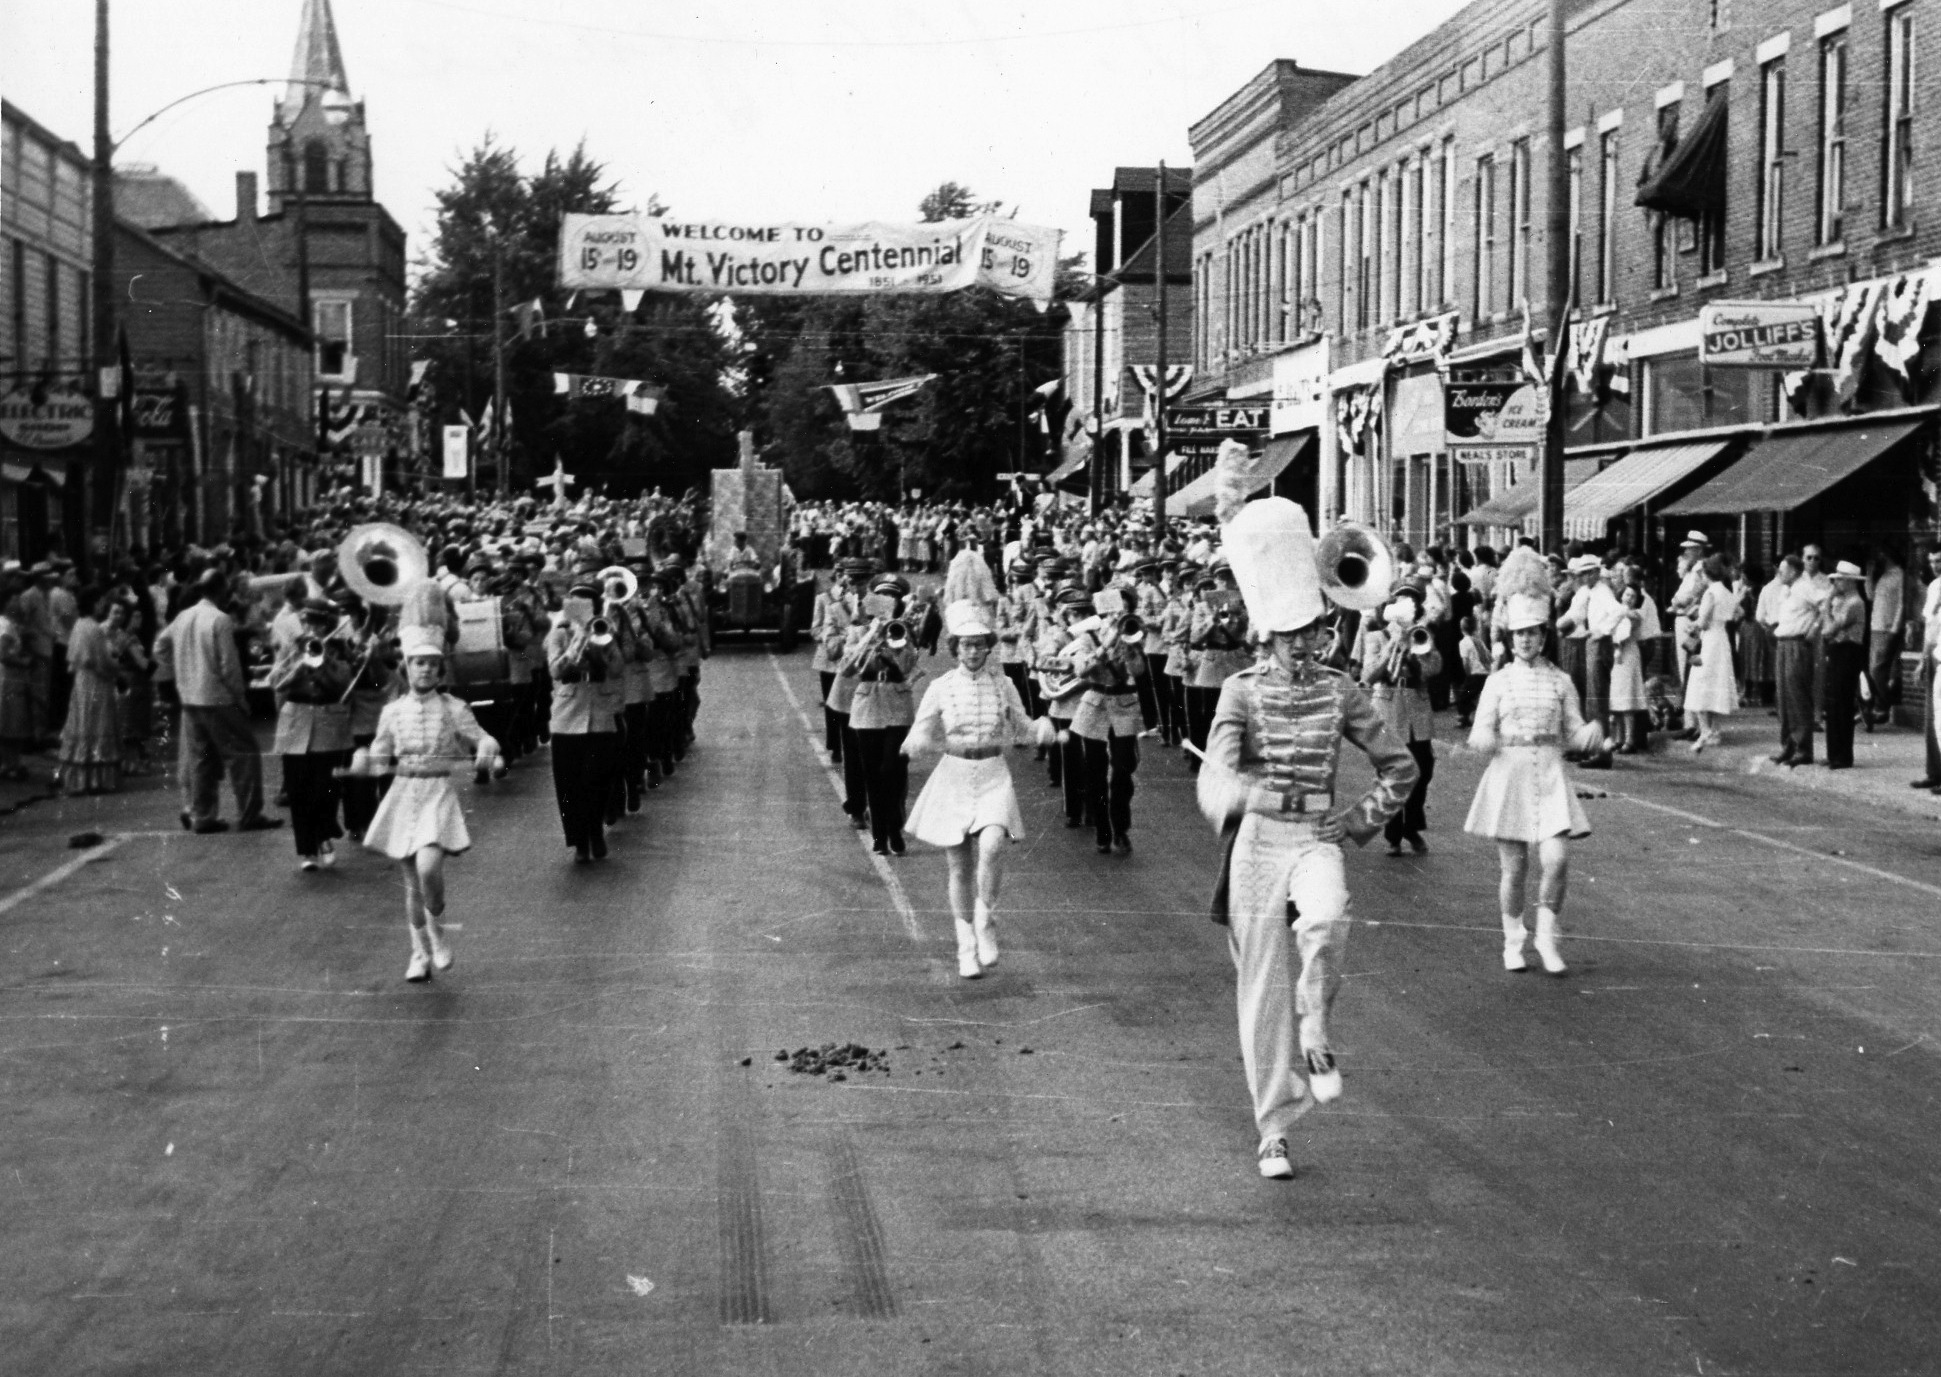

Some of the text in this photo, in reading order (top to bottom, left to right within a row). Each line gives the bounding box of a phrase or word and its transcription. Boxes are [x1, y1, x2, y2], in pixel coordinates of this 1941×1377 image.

[584, 231, 637, 244] AUGUST
[661, 223, 824, 242] WELCOME TO
[985, 232, 1032, 253] AUGUST
[661, 235, 963, 288] Mt. Victory Centennial
[1216, 409, 1263, 428] EAT
[1508, 405, 1523, 415] ICE
[1502, 418, 1536, 428] CREAM
